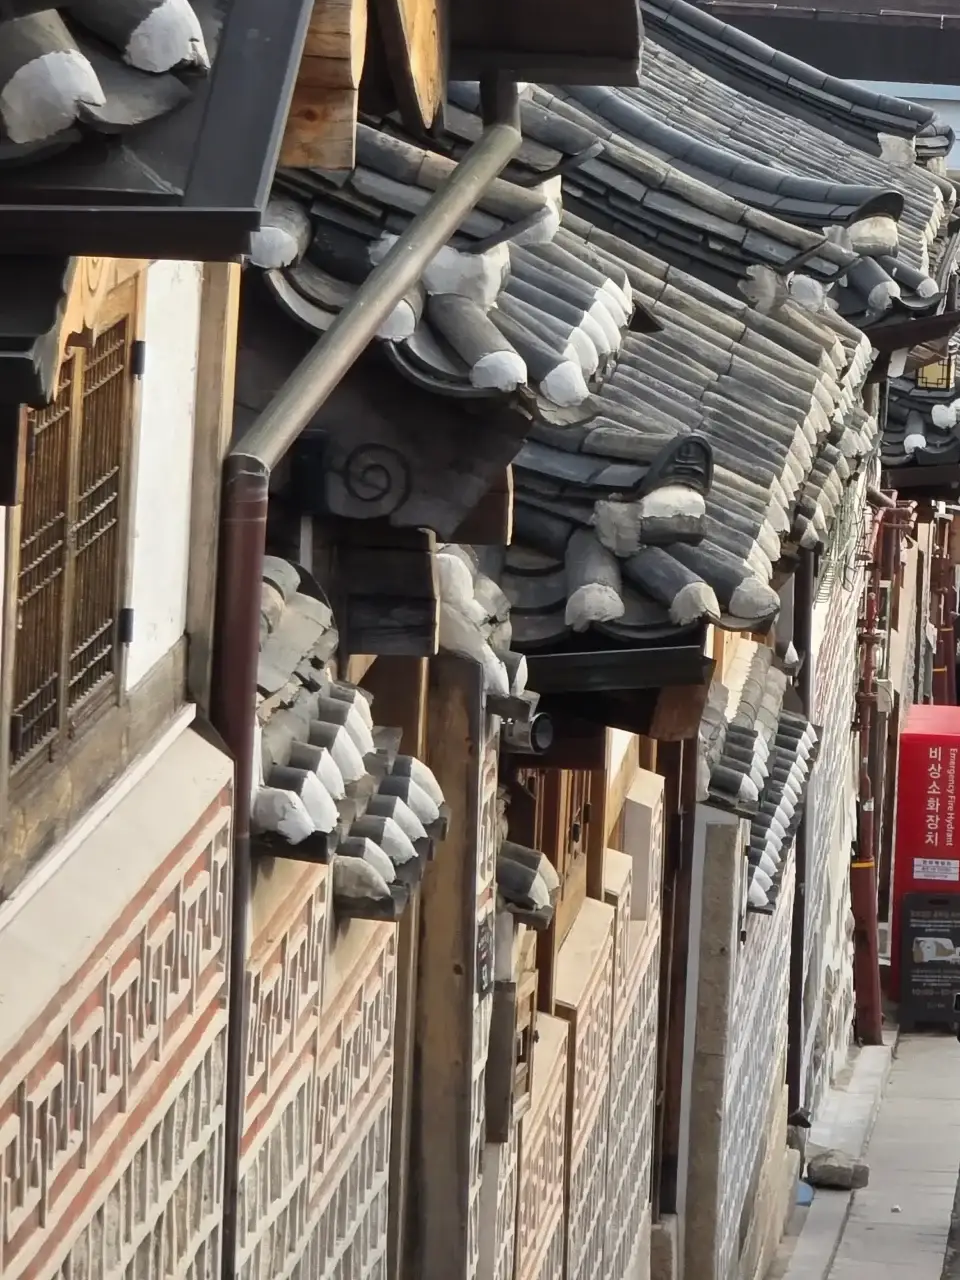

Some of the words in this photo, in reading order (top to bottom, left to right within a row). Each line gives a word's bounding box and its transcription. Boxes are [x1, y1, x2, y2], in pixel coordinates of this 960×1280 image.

[946, 748, 958, 795] Emergency
[925, 747, 942, 847] 비상소화장치
[947, 795, 956, 812] Fire
[944, 812, 955, 846] Hydrant
